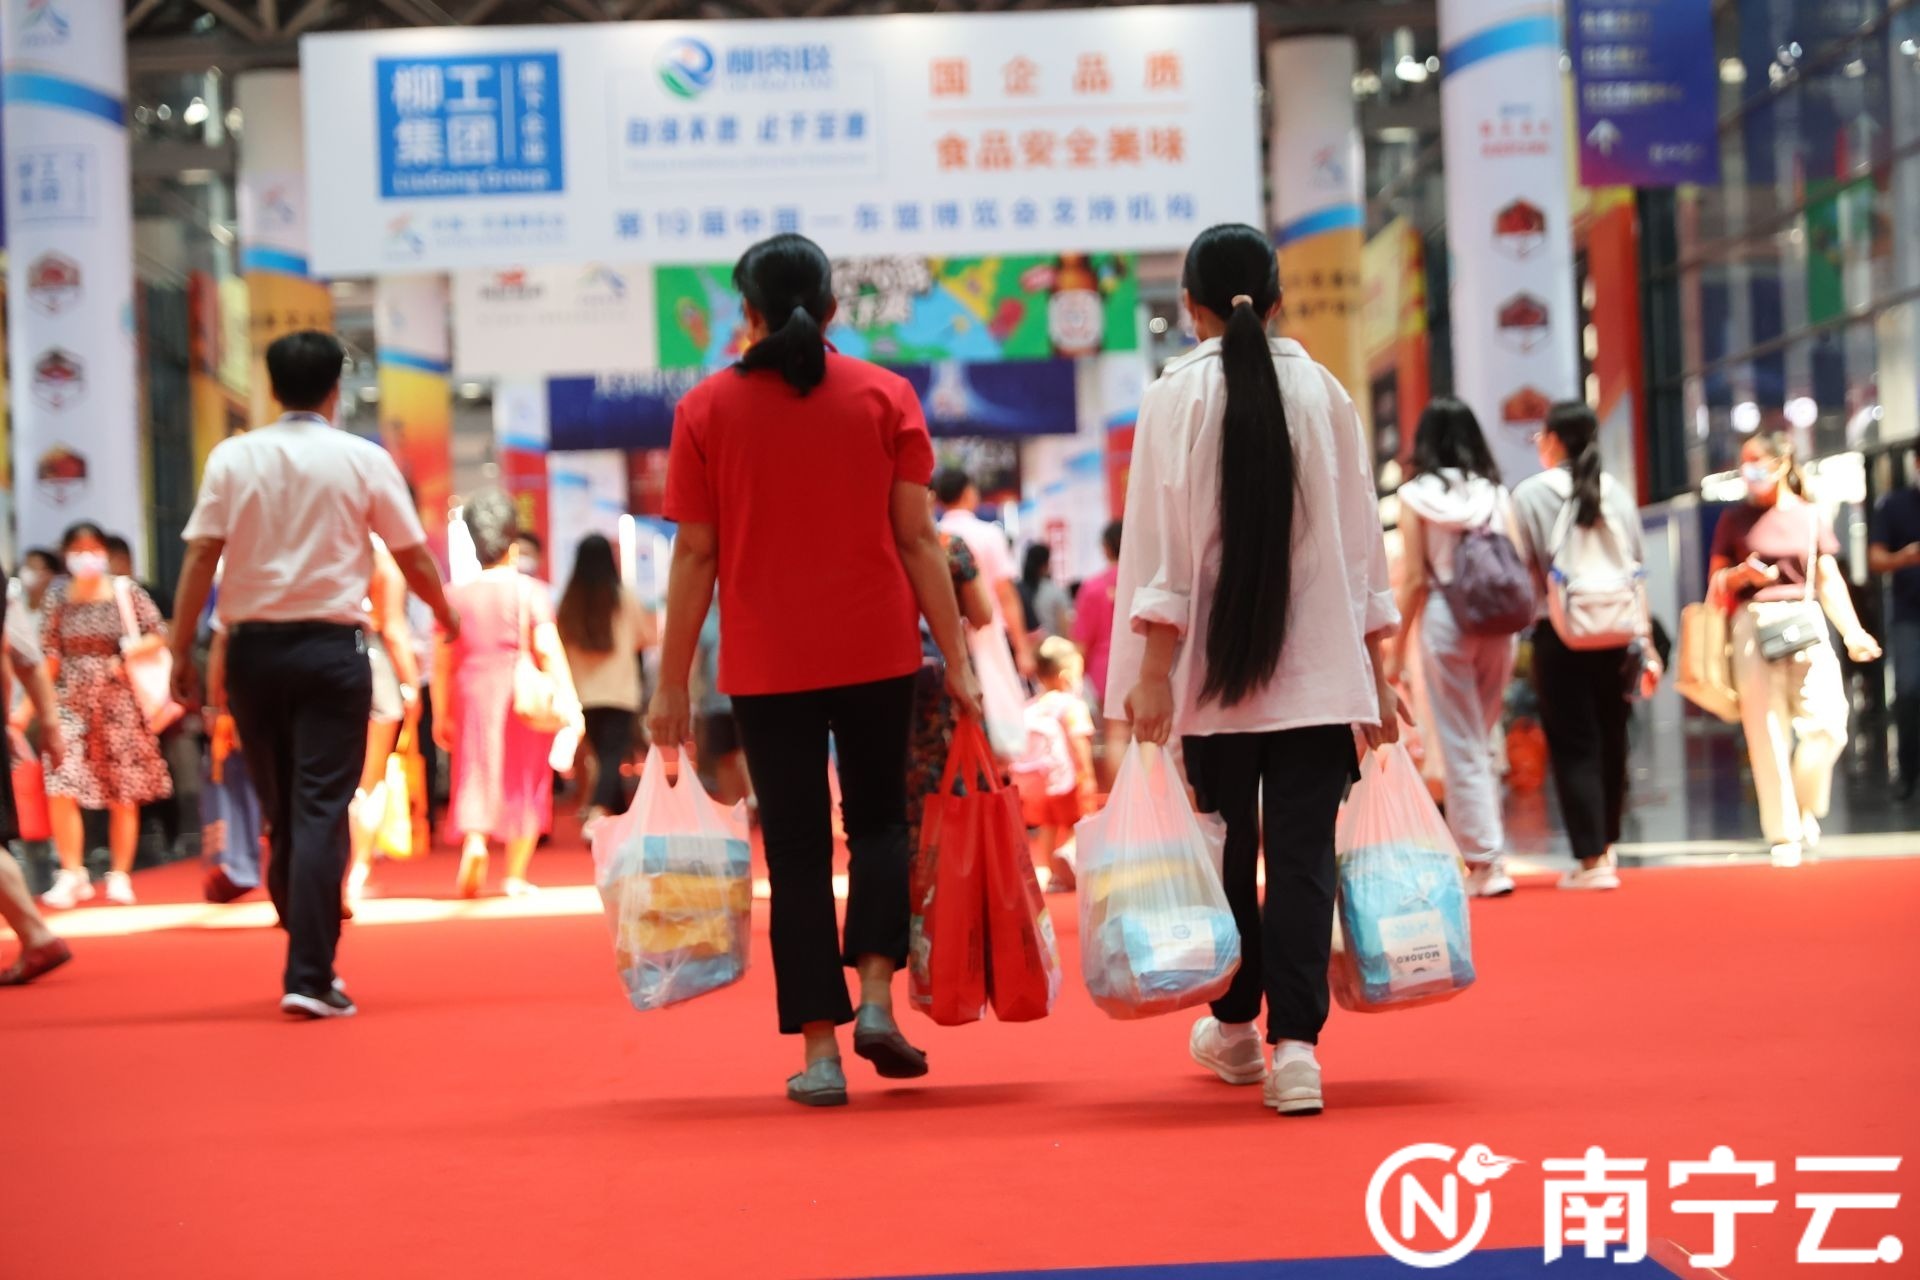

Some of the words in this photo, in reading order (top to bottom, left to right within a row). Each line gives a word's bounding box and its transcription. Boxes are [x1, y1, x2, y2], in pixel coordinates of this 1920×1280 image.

[392, 64, 497, 115] 柳工
[930, 53, 1184, 97] 国企品质
[393, 116, 498, 167] 集团
[937, 126, 1186, 171] 食品安全美味
[1396, 950, 1441, 964] МОЛОКО
